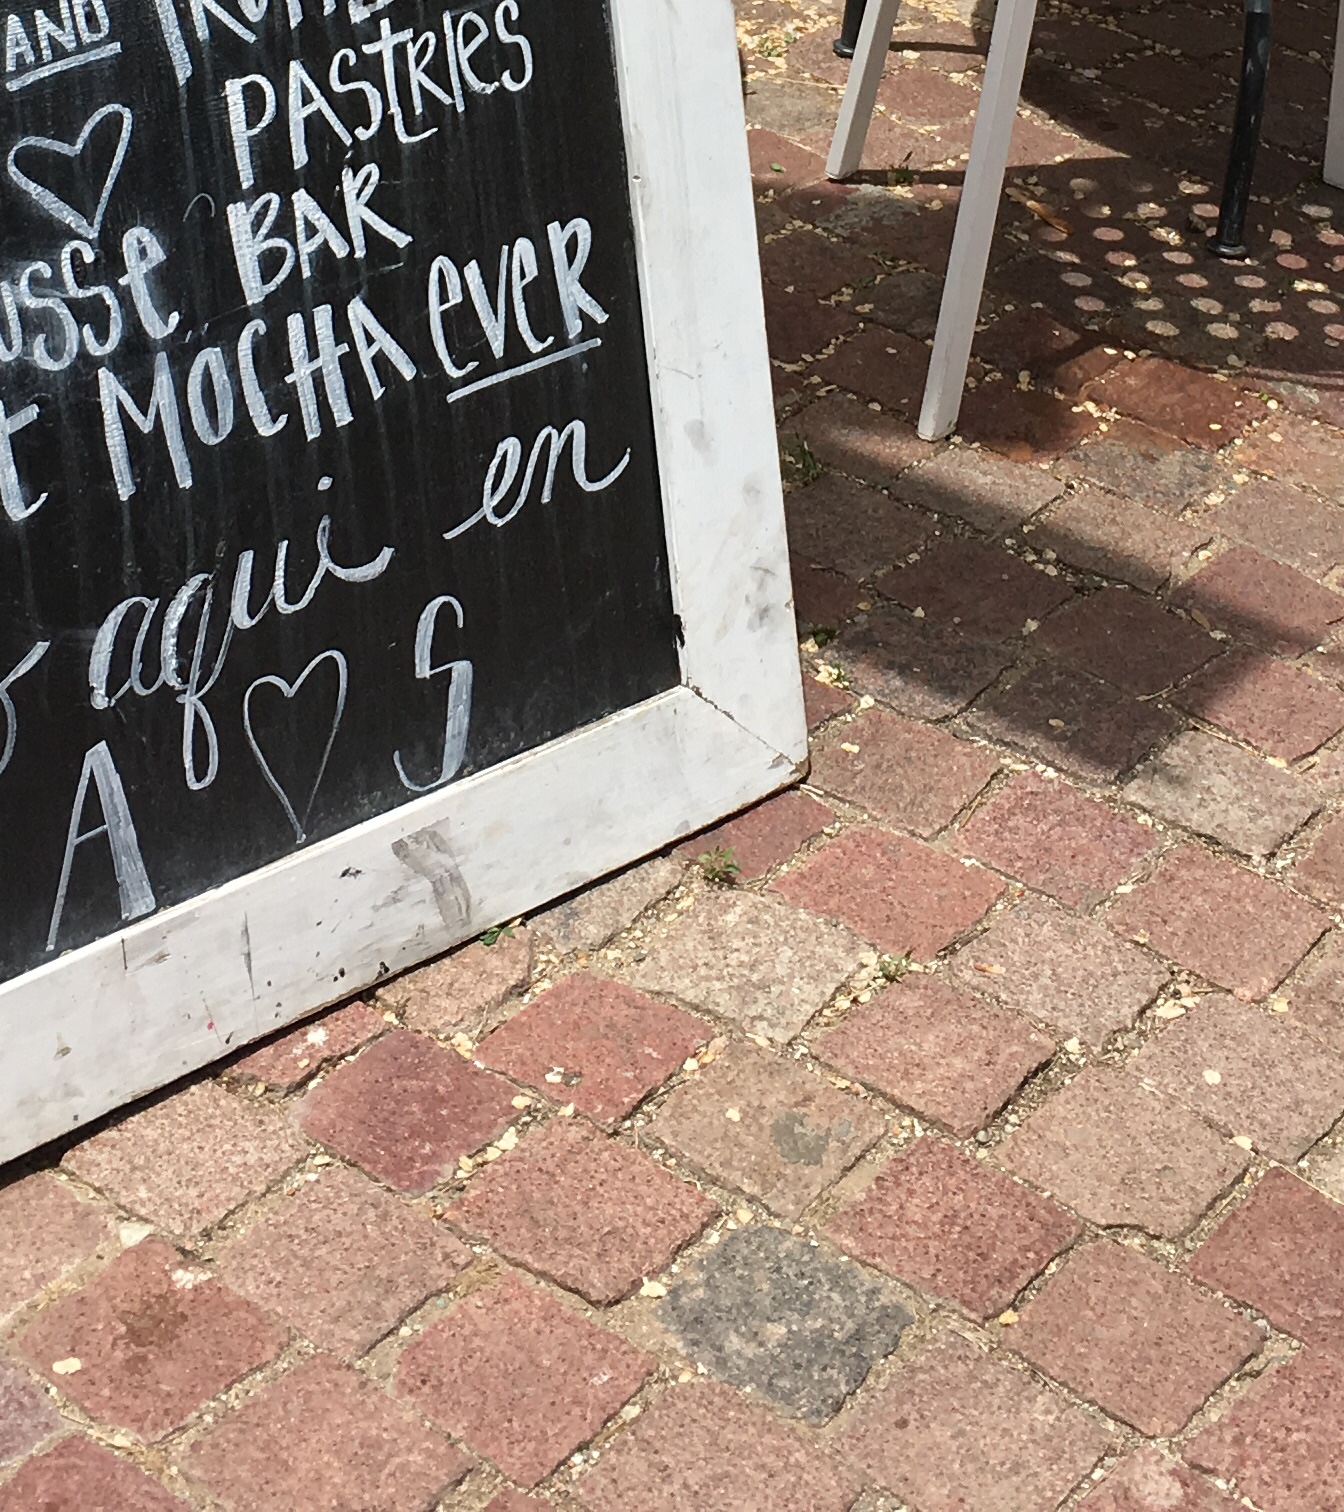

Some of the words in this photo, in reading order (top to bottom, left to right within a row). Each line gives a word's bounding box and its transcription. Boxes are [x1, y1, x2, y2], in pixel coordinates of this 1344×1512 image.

[226, 162, 414, 306] BAR
[98, 296, 417, 502] MOCHA
[442, 419, 631, 539] en
